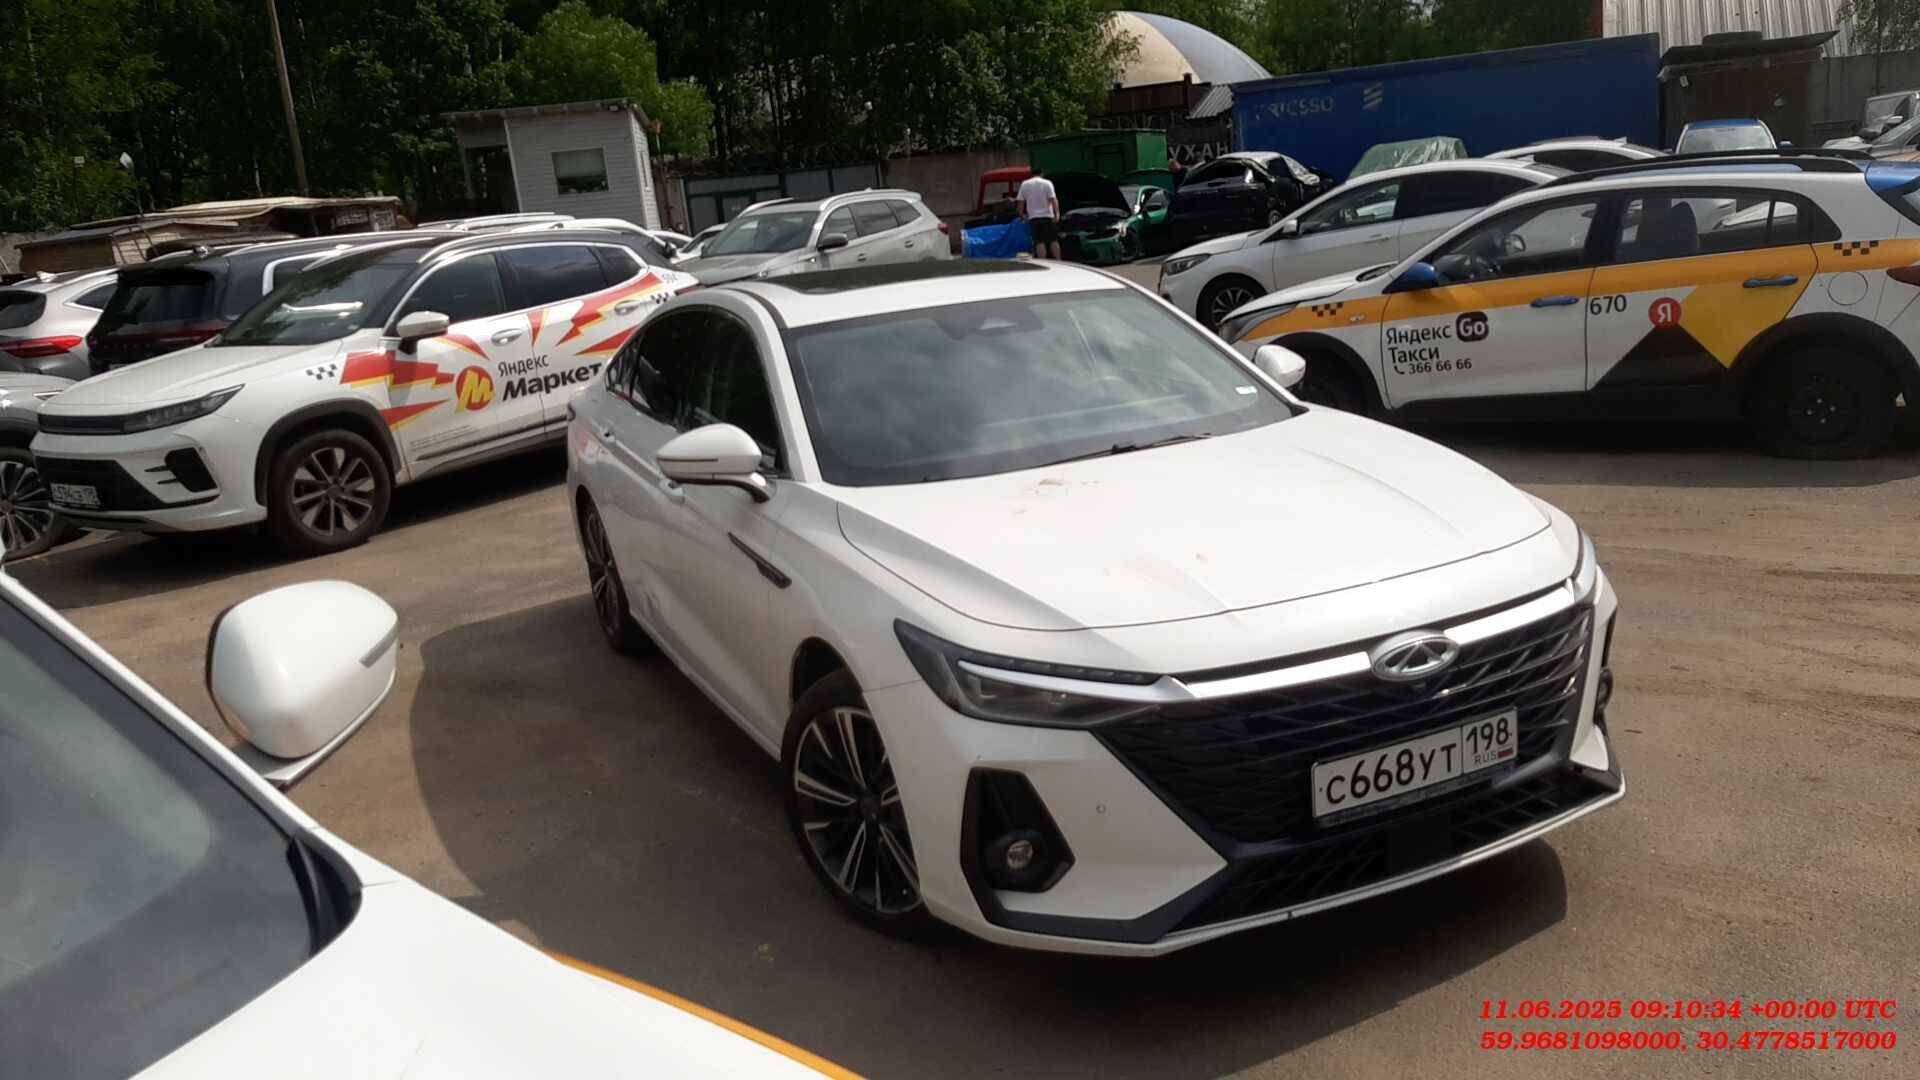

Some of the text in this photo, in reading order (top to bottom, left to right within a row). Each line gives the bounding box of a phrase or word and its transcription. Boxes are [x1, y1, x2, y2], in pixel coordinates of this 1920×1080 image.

[1590, 294, 1627, 315] 670
[1657, 303, 1672, 322] Я
[1386, 317, 1486, 345] Яндекс Go
[498, 354, 550, 377] Яндекс
[1387, 347, 1440, 364] Такси
[1409, 358, 1473, 375] 366 66 66
[502, 362, 602, 402] Маркет
[1466, 717, 1509, 754] 198
[1474, 753, 1497, 766] RUS
